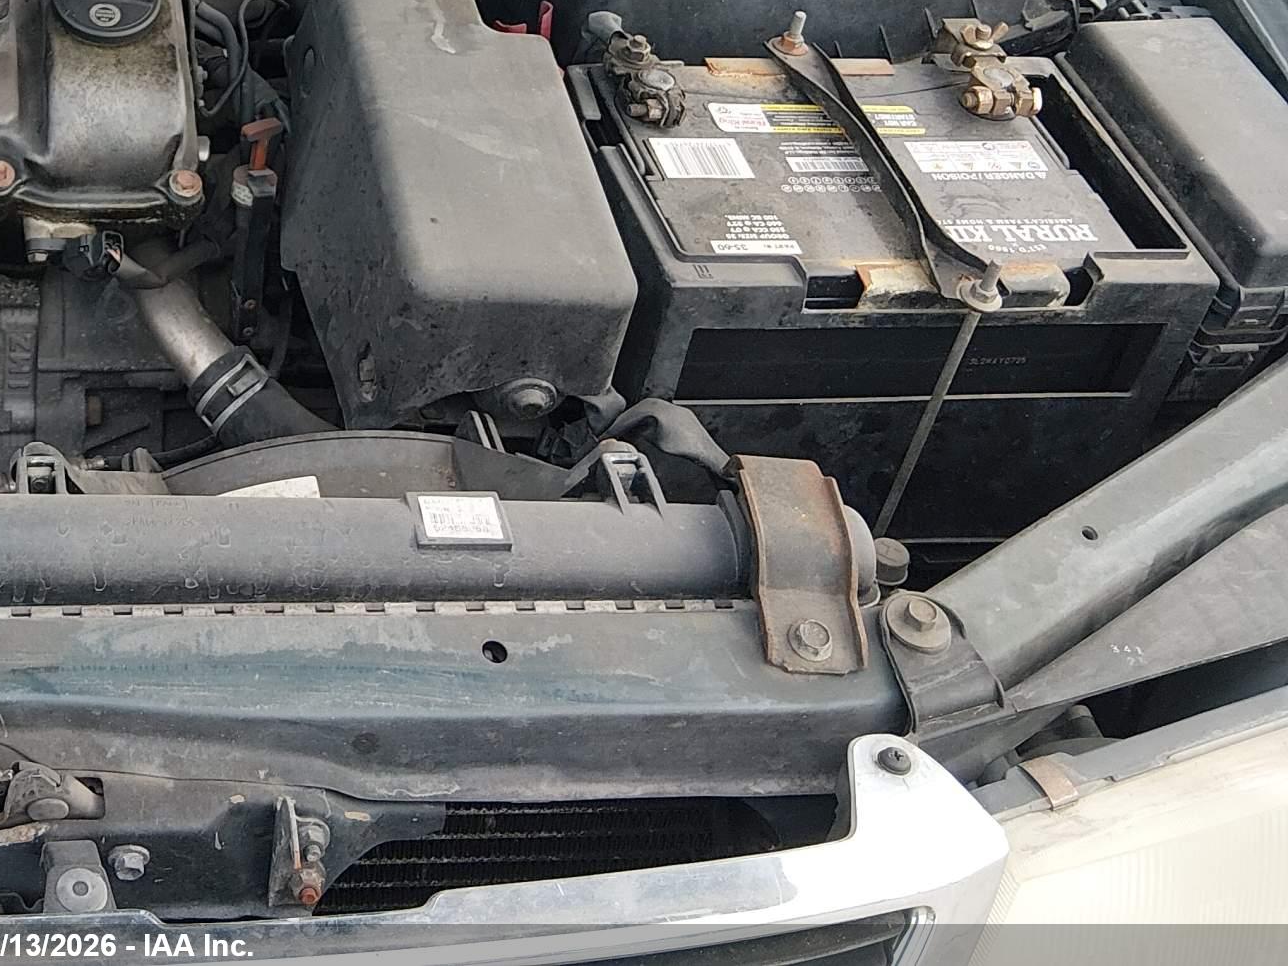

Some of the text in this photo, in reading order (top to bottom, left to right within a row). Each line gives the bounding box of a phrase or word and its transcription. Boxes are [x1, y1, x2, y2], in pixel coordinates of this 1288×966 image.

[930, 172, 978, 180] POISON
[982, 170, 1036, 179] DANGER
[943, 224, 1099, 243] RURAL KI
